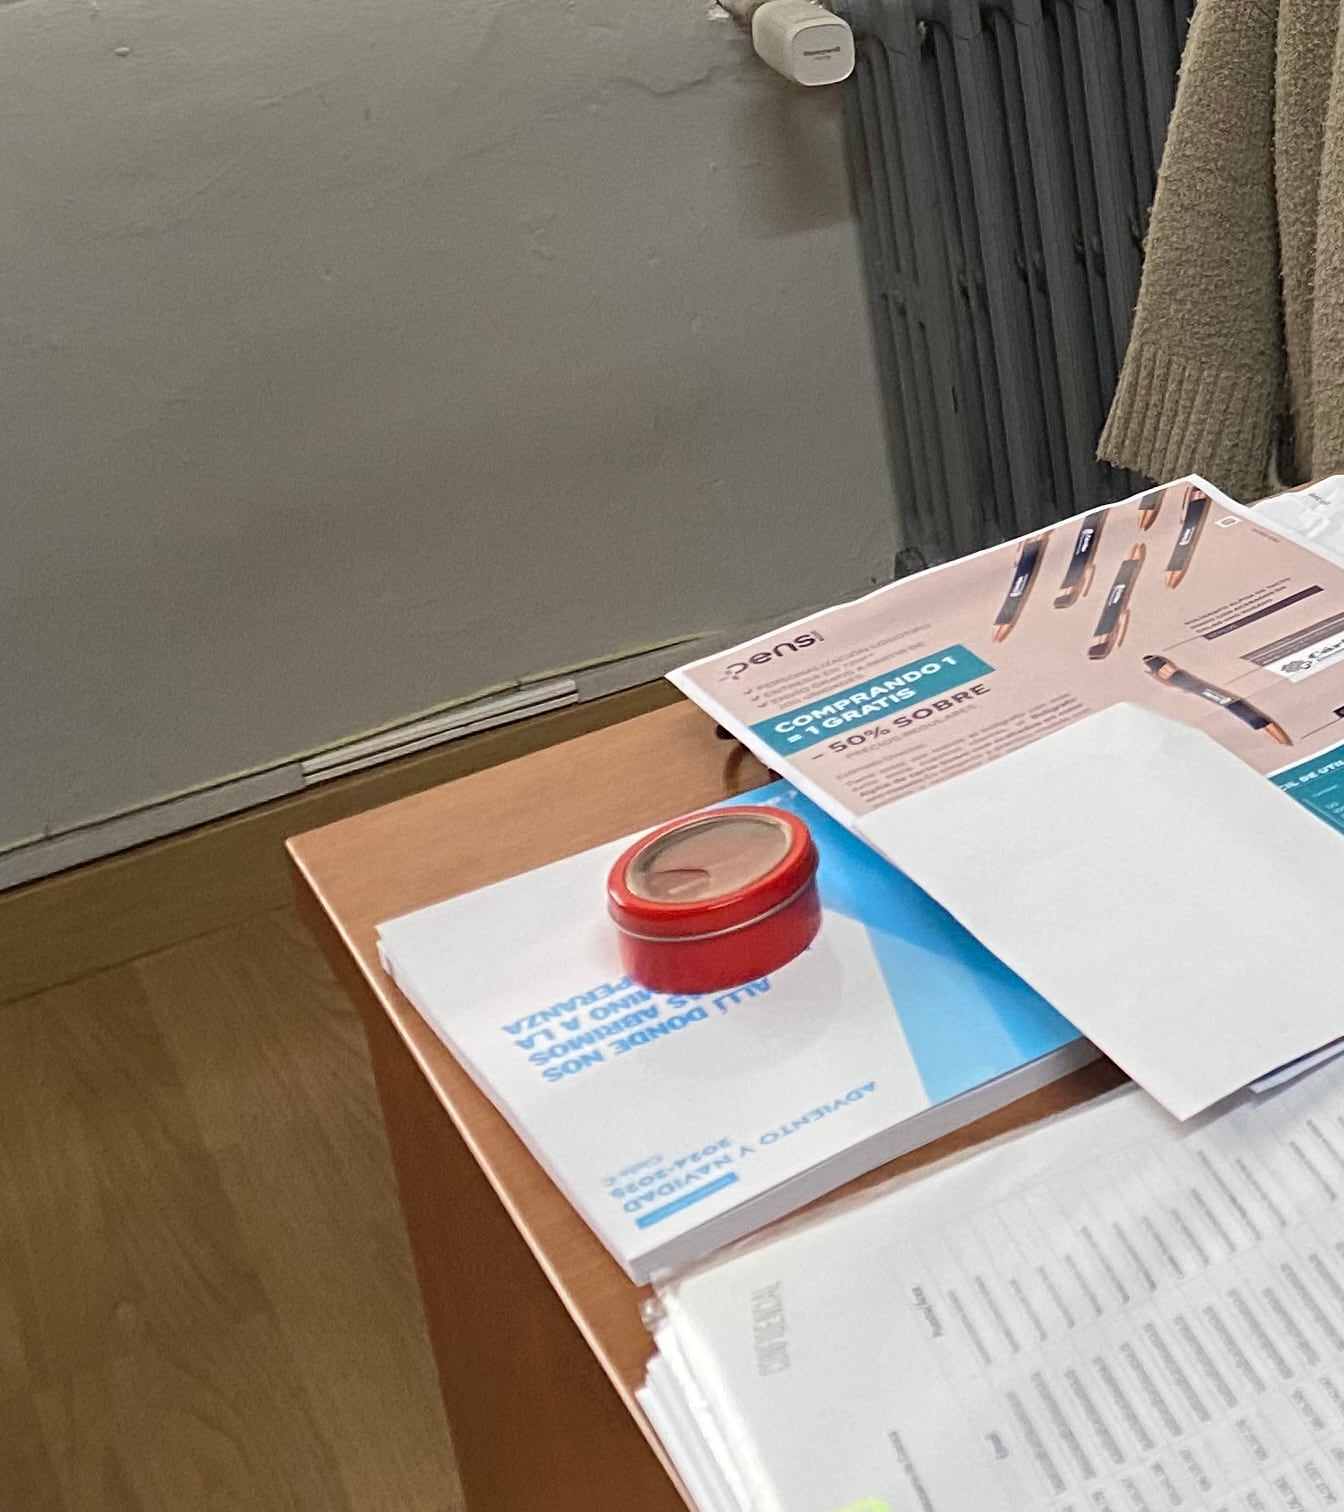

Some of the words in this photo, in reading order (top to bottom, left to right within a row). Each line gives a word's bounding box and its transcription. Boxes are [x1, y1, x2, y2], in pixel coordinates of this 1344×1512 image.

[773, 661, 939, 735] COMPRANDO
[820, 685, 916, 730] GRATIS
[827, 723, 891, 755] 50%
[890, 682, 991, 729] SOBRE
[712, 976, 772, 1016] ALLÍ
[512, 1025, 555, 1054] LA
[526, 1005, 660, 1067] ABRIMOS
[557, 1014, 582, 1036] A
[608, 1005, 708, 1056] DONDE
[539, 1048, 606, 1084] NOS
[758, 1080, 877, 1147] ADVIENTO
[608, 1137, 731, 1199] 2024-2025
[736, 1142, 754, 1157] Y
[620, 1152, 733, 1214] NAVIDAD
